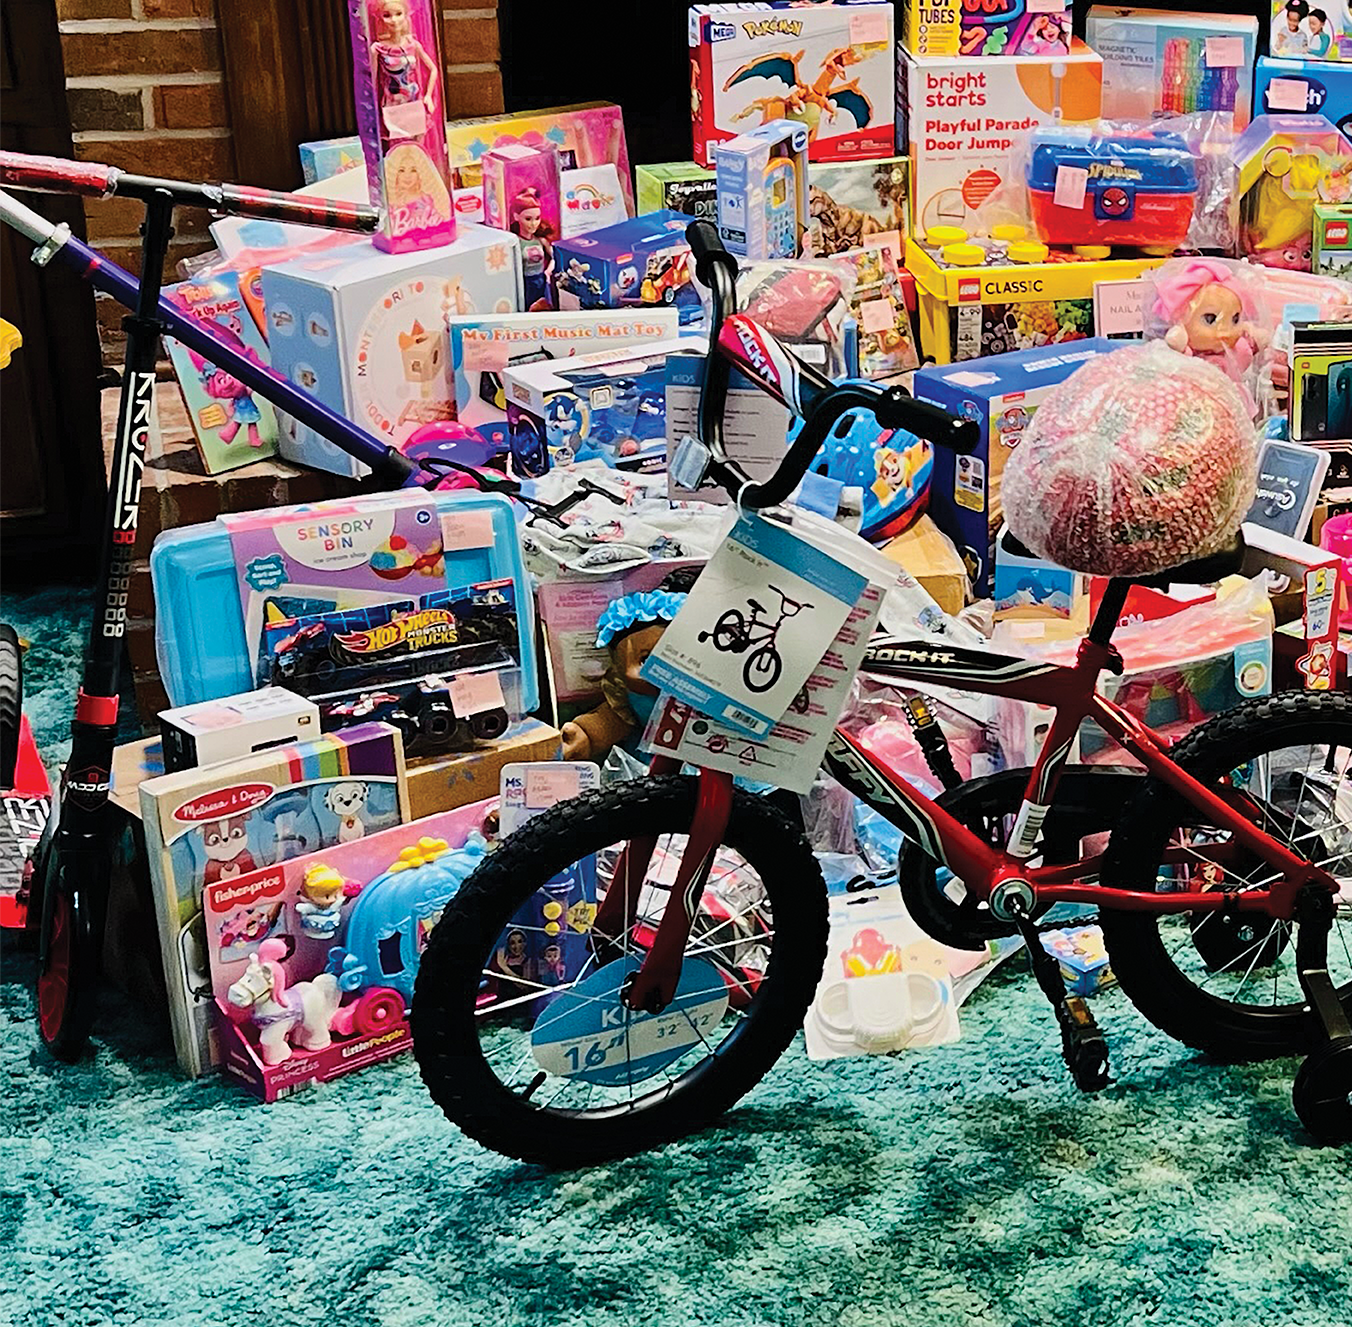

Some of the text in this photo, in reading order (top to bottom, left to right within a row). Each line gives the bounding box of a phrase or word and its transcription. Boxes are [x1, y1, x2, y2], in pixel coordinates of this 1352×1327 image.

[918, 9, 955, 24] TUBES
[926, 72, 987, 93] bright
[926, 91, 987, 107] starts
[925, 118, 981, 135] Playful
[925, 137, 1018, 152] Door Jump
[395, 207, 443, 237] Barbie
[985, 279, 1044, 295] CLASSIC
[1110, 305, 1132, 314] NAIL
[491, 328, 538, 342] First
[543, 326, 593, 340] Music
[597, 324, 629, 338] Mat
[632, 322, 666, 338] Toy
[297, 518, 374, 541] SENSORY
[324, 536, 354, 552] BIN
[1315, 568, 1327, 593] 5
[367, 625, 401, 652] HOT
[407, 624, 456, 639] MONSTER
[408, 631, 459, 653] TRUCKS
[182, 798, 229, 818] Melissa
[240, 789, 270, 805] Doug
[213, 874, 282, 905] fisher-price
[270, 1060, 320, 1085] PRINCESS
